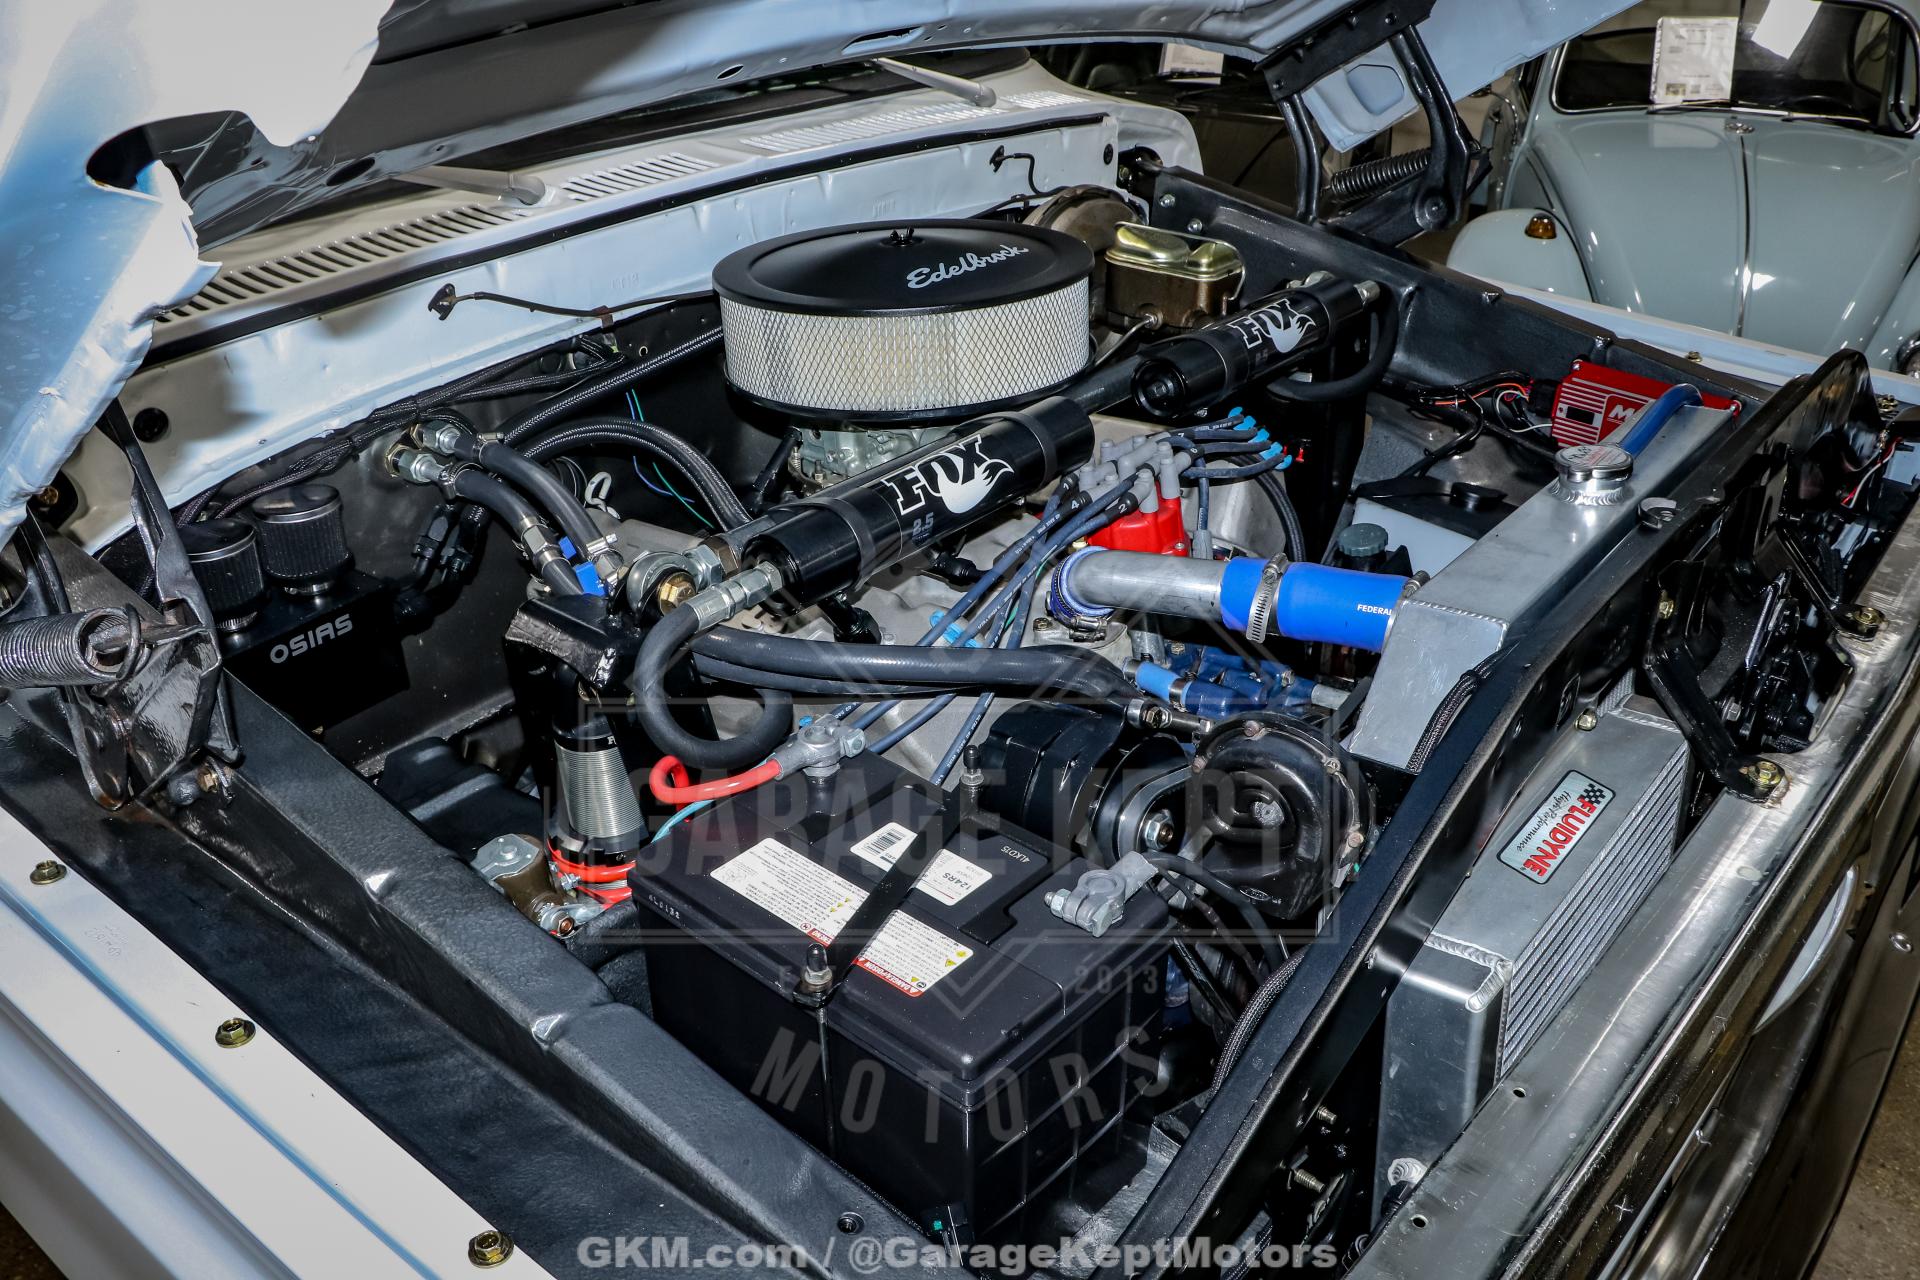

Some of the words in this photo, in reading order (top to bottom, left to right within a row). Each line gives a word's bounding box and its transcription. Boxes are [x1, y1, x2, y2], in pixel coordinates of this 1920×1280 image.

[906, 244, 1029, 289] Edelbrock
[1227, 298, 1315, 352] FOX
[880, 434, 1013, 514] FOX
[1071, 500, 1080, 509] 4
[1118, 503, 1128, 513] 2
[1357, 603, 1393, 616] FEDERAL
[270, 613, 353, 664] OSIAS
[1517, 809, 1560, 852] Performance
[1523, 795, 1597, 877] FLUIDYNE
[942, 872, 972, 890] 124RS
